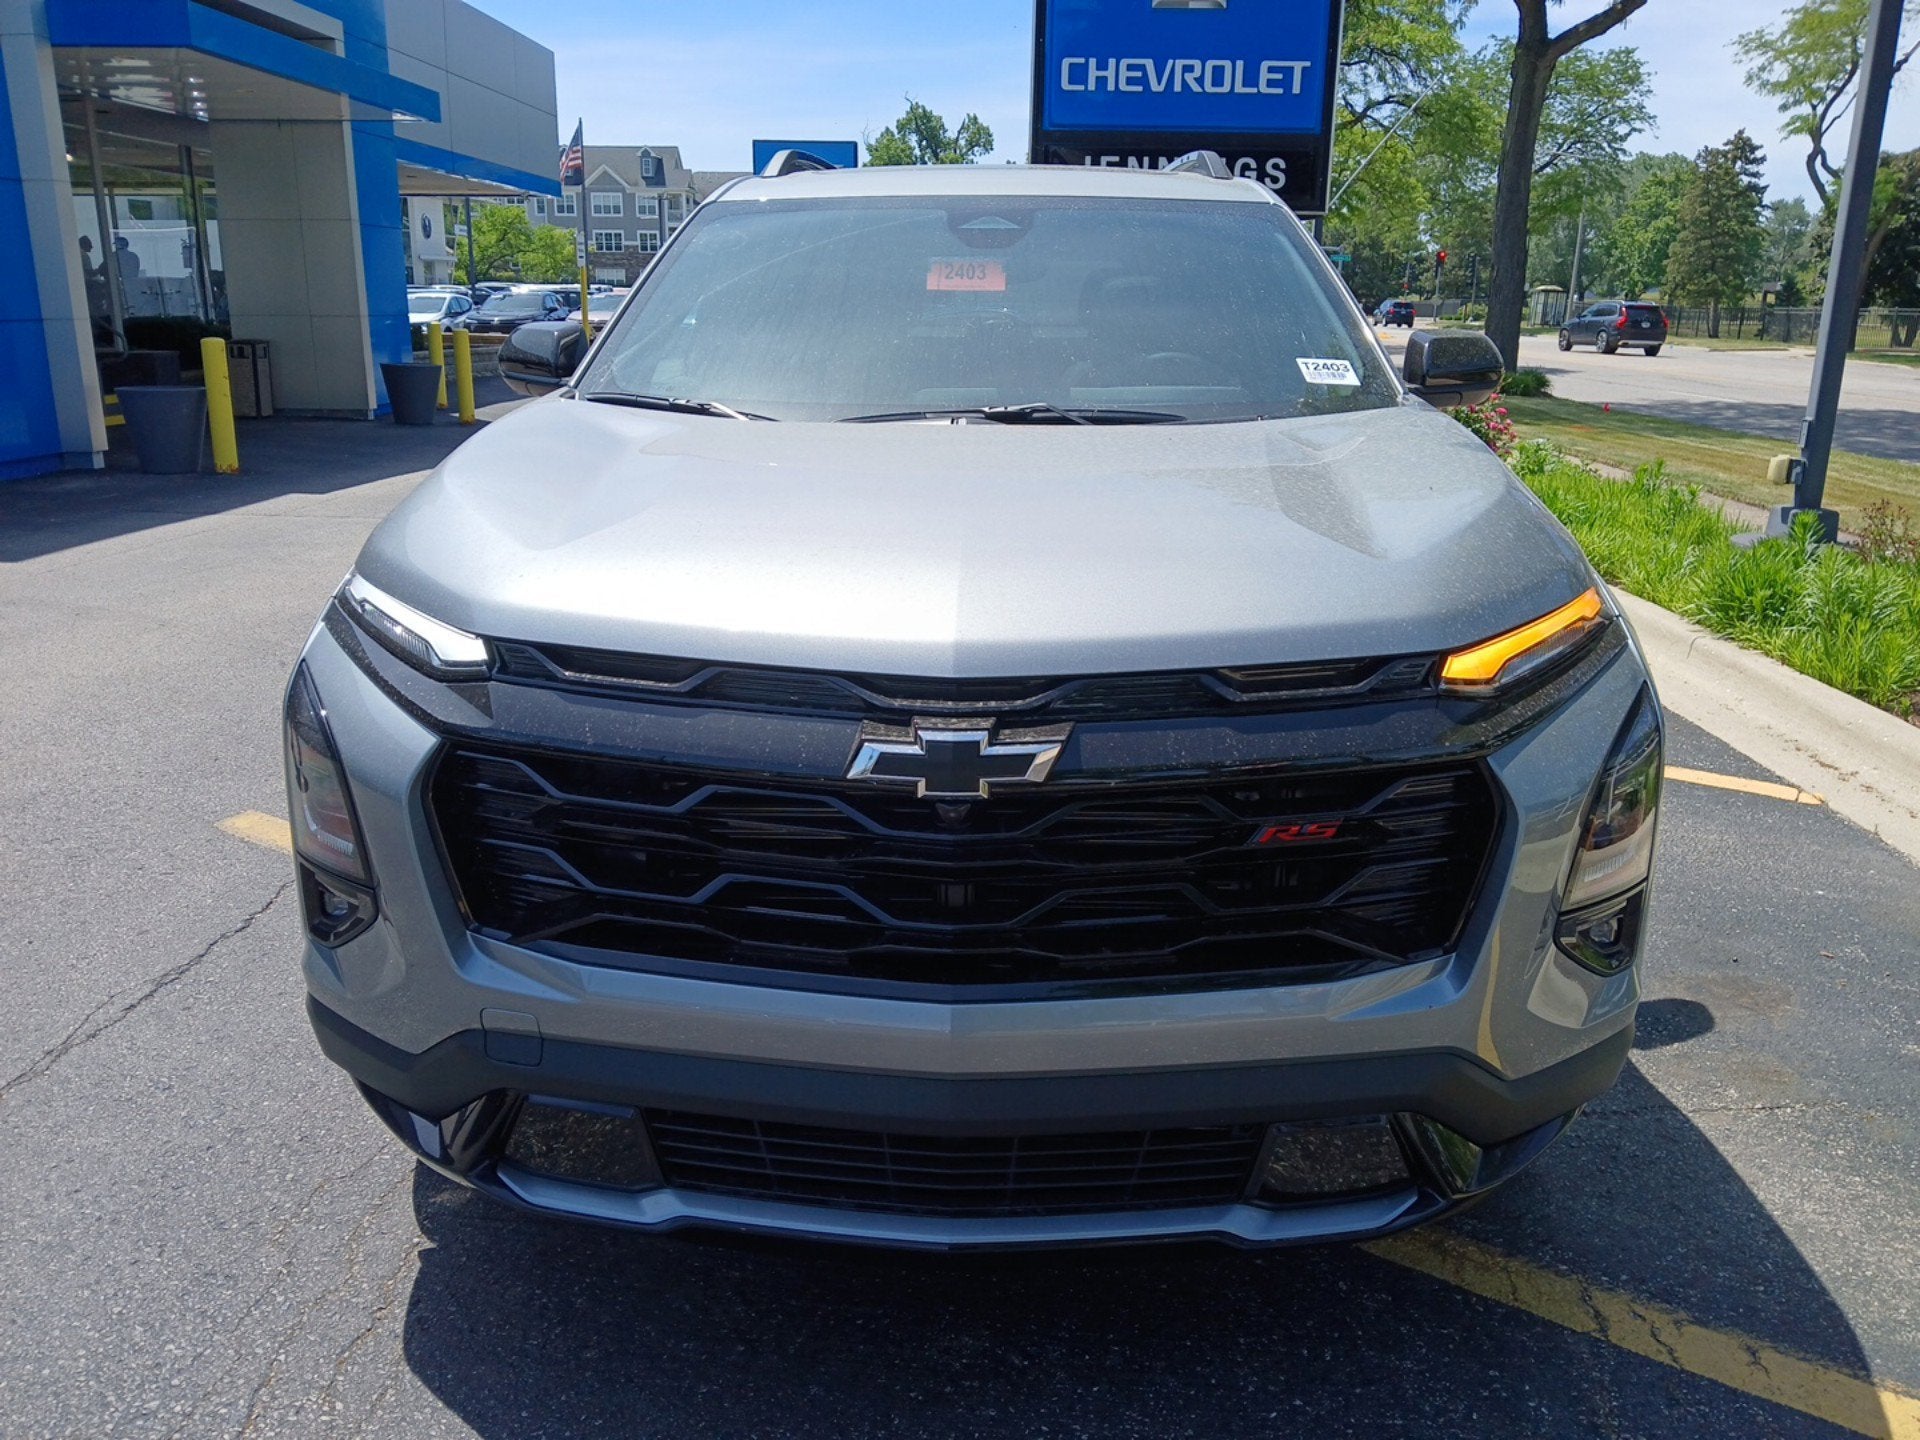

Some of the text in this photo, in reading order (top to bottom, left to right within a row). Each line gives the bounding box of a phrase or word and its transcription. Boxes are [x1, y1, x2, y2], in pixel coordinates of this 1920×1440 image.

[1060, 56, 1312, 95] CHEVROLET
[1301, 362, 1350, 373] T2403
[1258, 817, 1344, 844] RS
